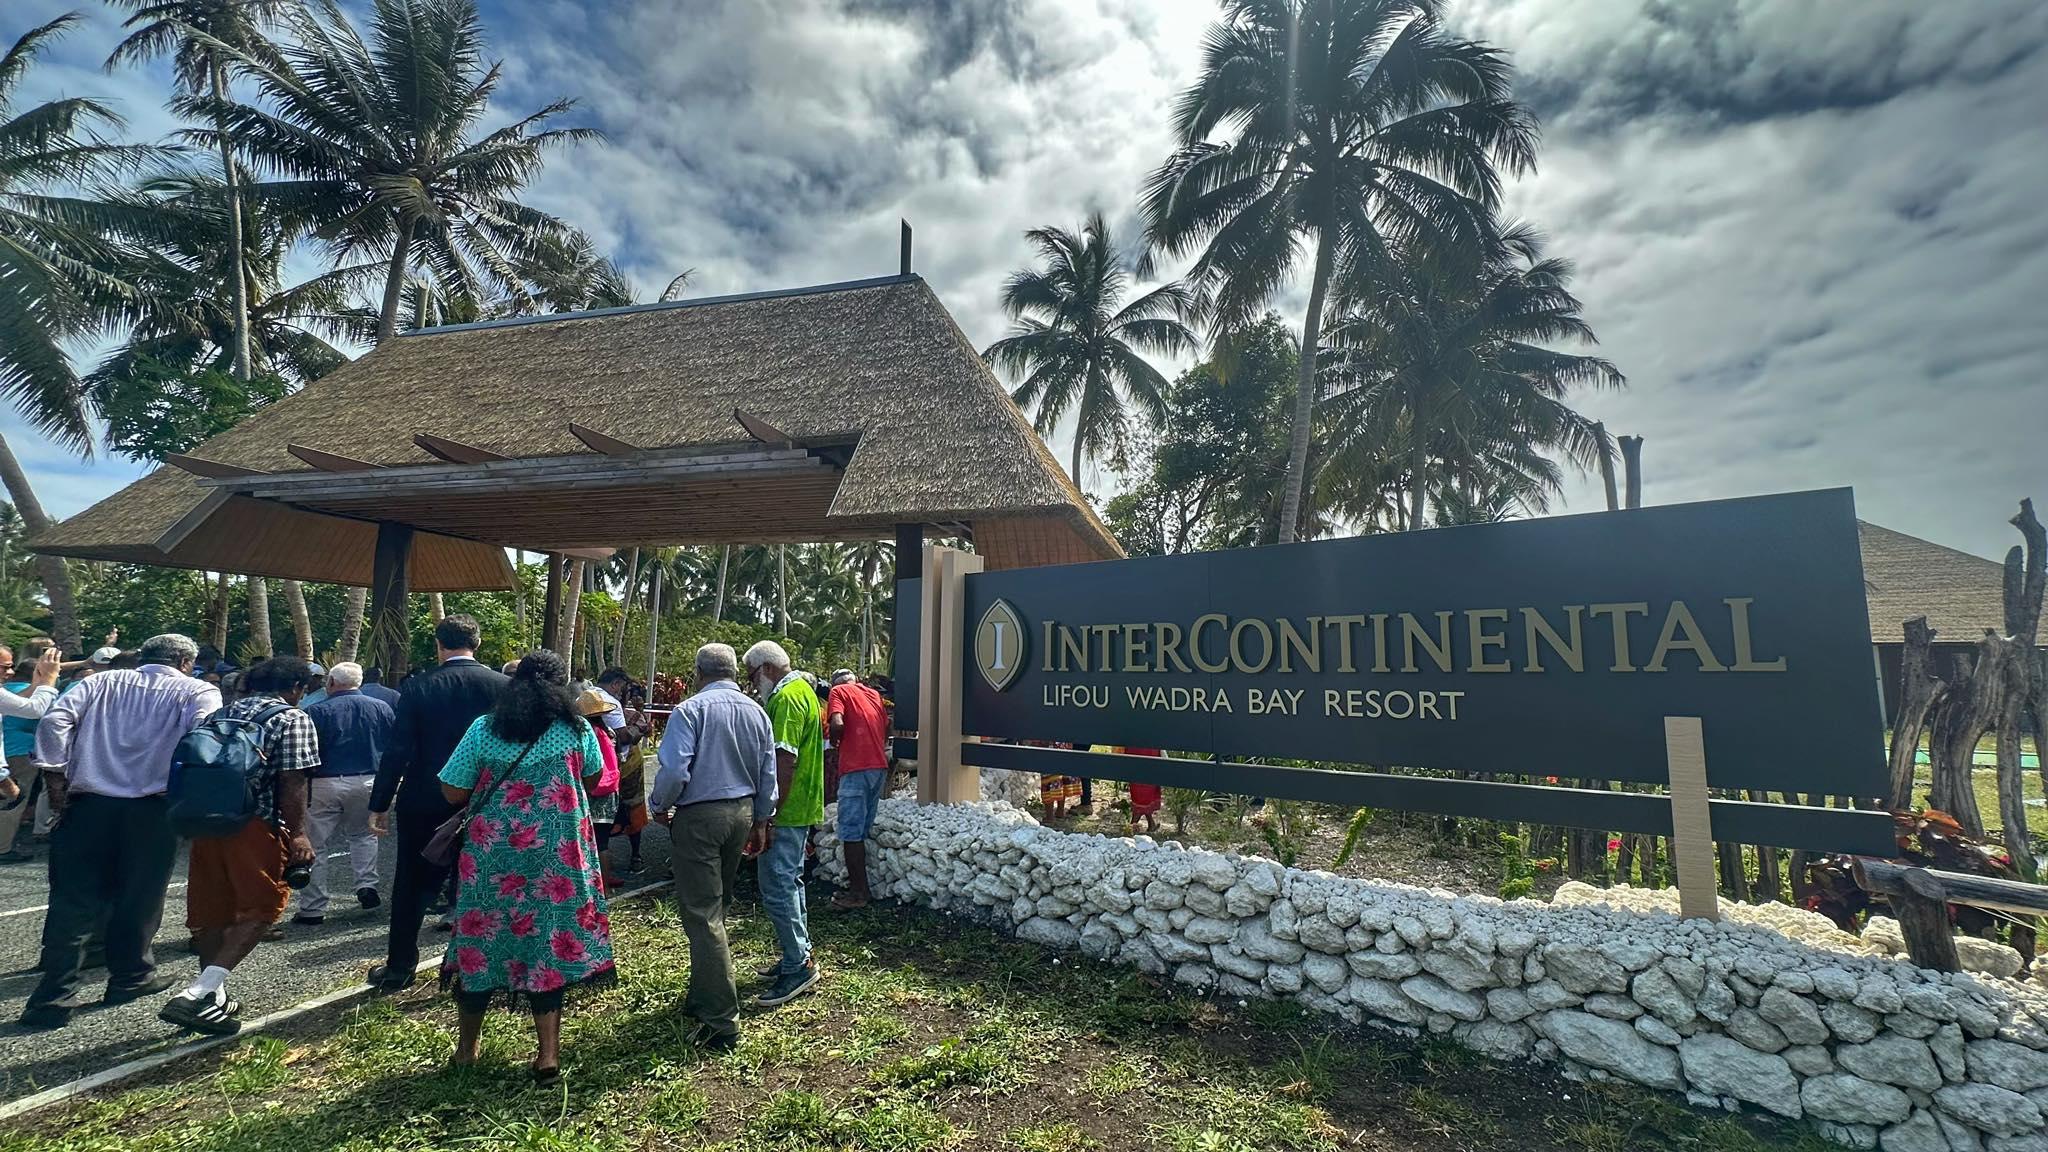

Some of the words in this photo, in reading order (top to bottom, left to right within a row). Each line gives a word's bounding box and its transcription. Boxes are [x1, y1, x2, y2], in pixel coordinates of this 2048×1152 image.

[988, 620, 1011, 670] I
[1041, 597, 1787, 673] INTERCONTINENTAL
[1043, 685, 1109, 708] LIFOU
[1125, 686, 1232, 713] WADRA
[1248, 688, 1305, 715] BAY
[1324, 690, 1466, 720] RESORT
